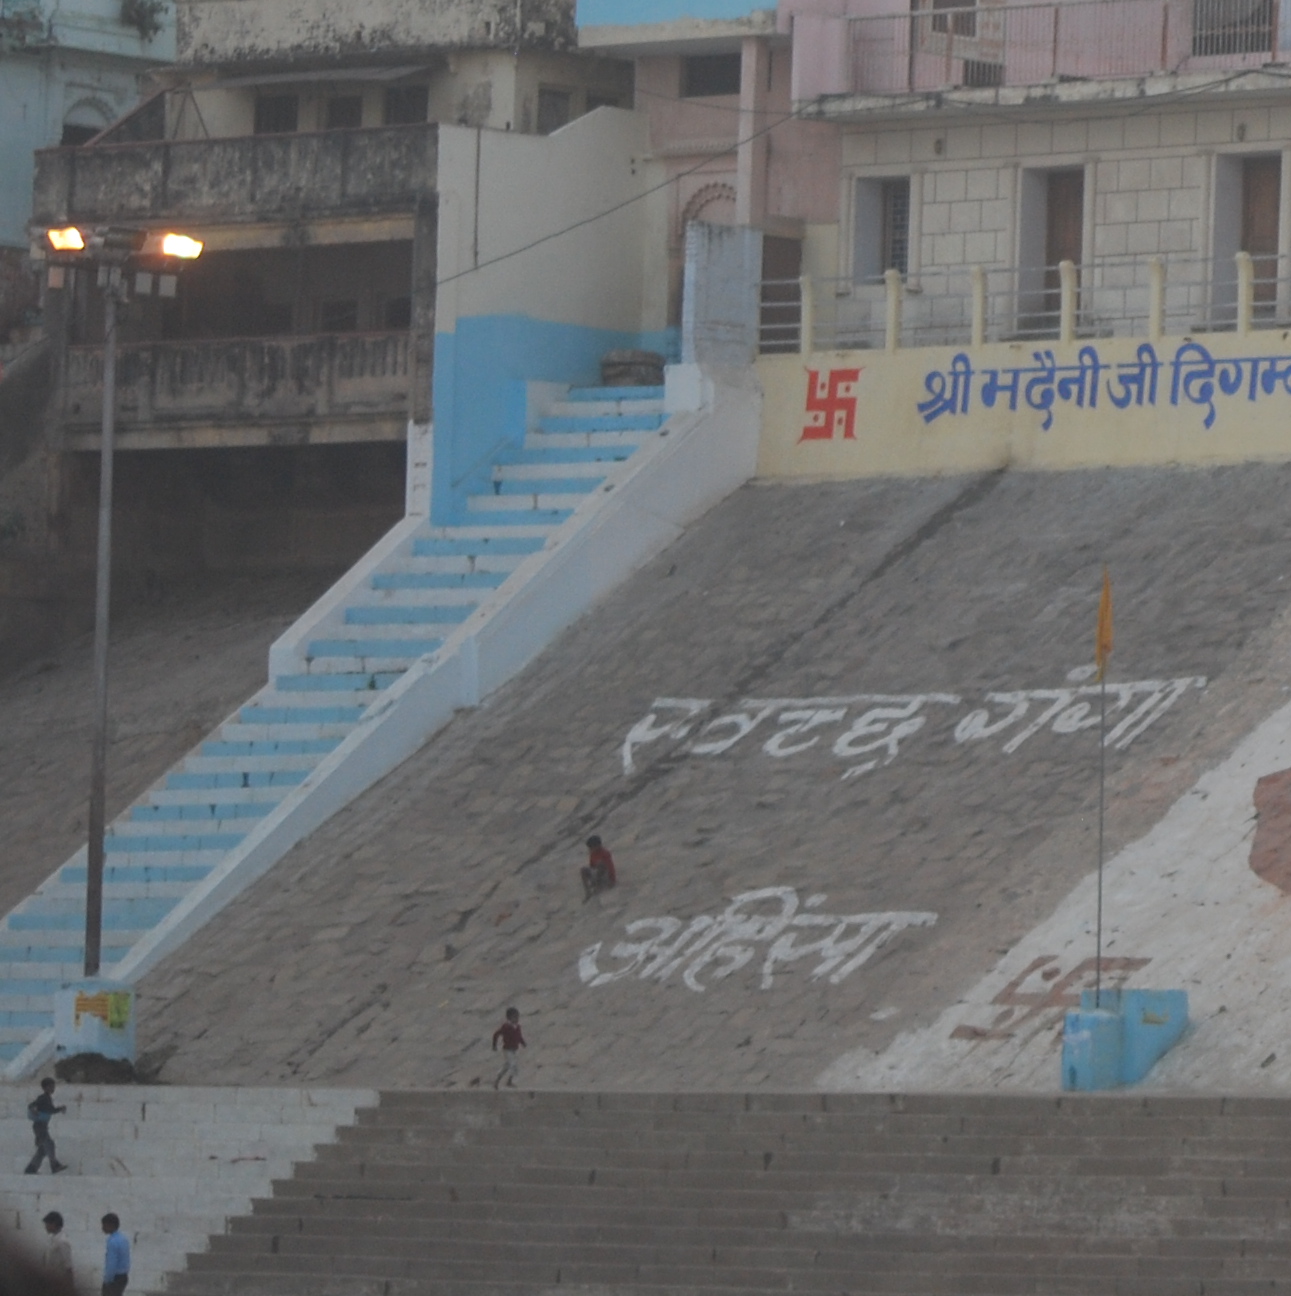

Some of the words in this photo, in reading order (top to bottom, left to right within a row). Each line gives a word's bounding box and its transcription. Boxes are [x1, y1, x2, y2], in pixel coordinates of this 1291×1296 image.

[916, 350, 974, 425] श्री
[1106, 343, 1163, 410] जी
[954, 662, 1209, 755] गंगा
[577, 885, 940, 993] अहिंसा
